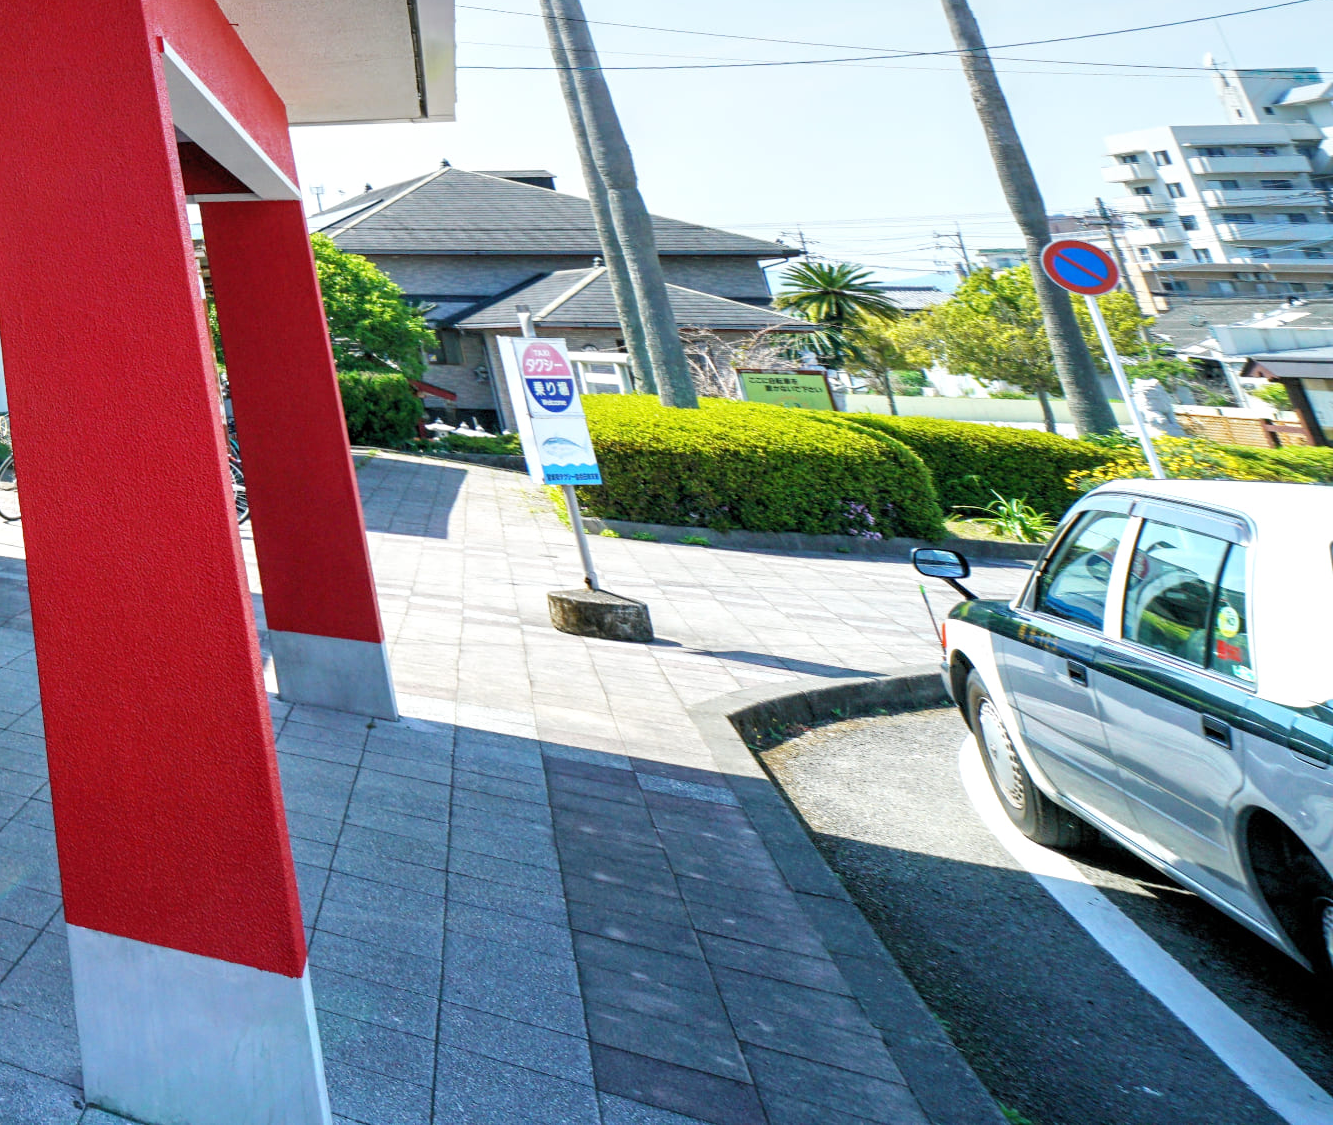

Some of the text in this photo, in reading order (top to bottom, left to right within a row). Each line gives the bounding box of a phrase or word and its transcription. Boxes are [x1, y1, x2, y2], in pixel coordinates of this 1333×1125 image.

[532, 349, 551, 357] TAXI
[525, 358, 563, 373] タクシー
